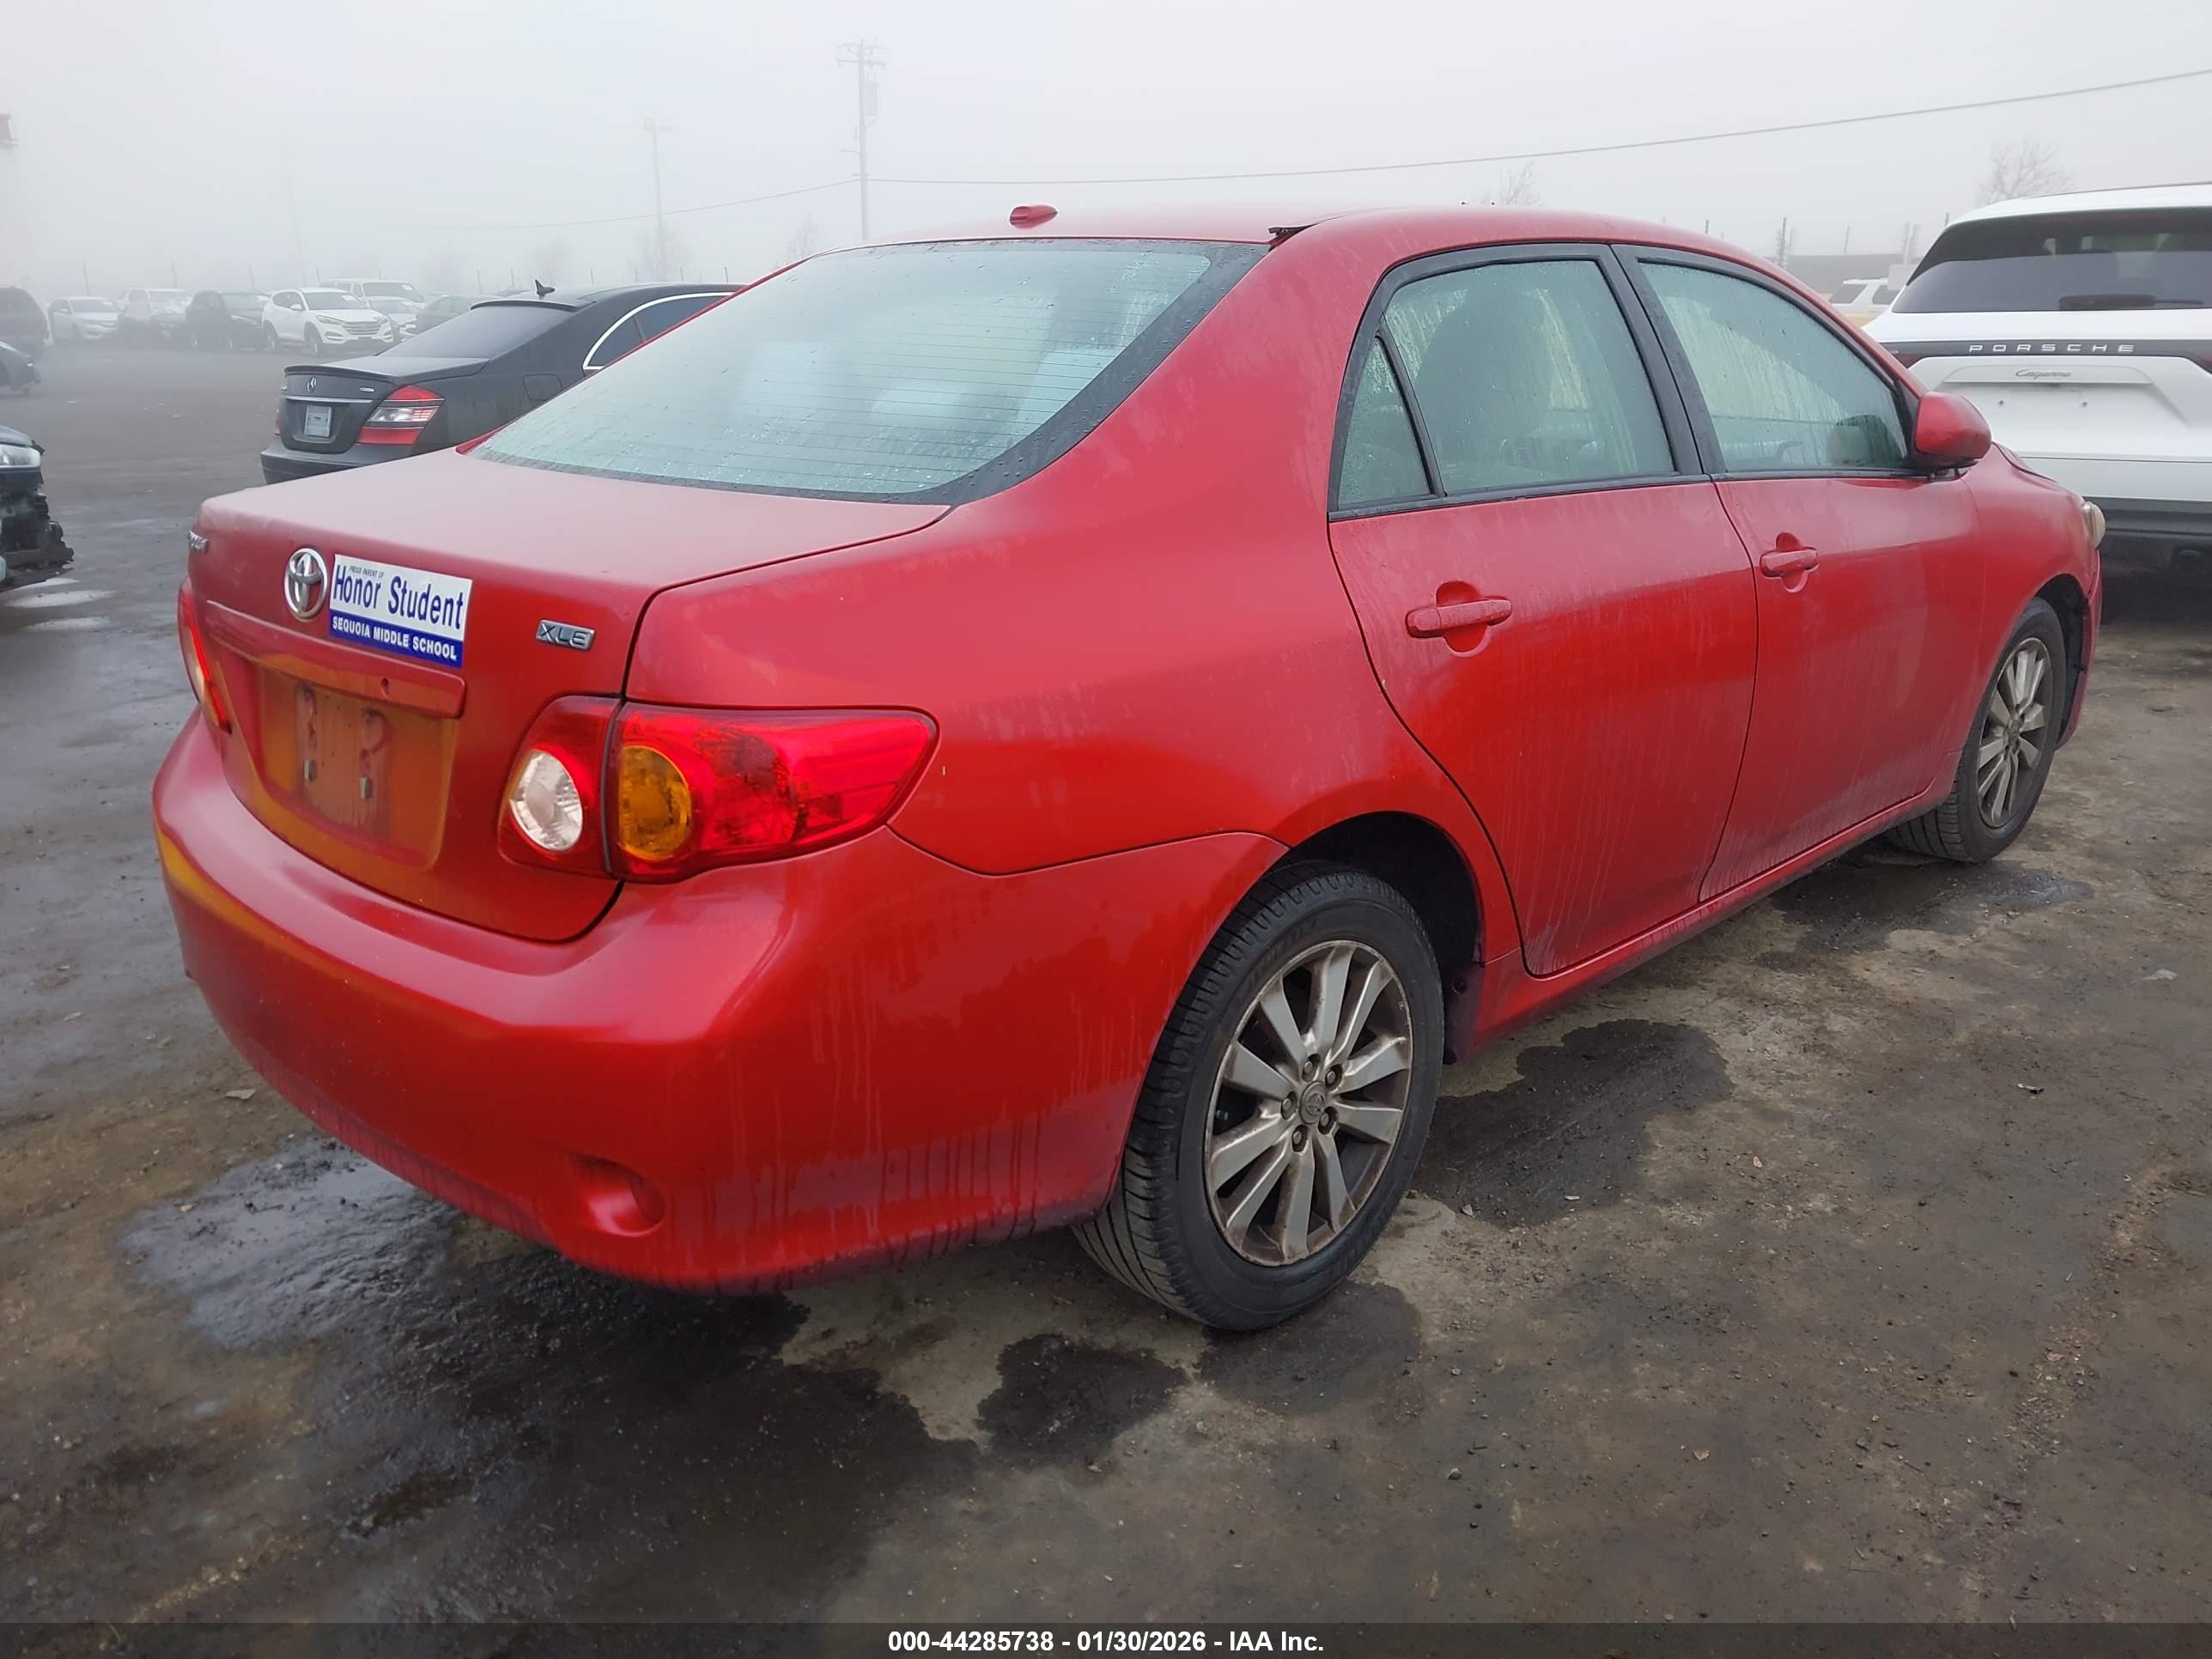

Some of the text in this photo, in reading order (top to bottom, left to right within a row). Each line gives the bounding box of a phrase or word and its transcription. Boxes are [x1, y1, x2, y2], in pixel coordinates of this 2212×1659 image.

[1969, 344, 2135, 353] PORSCHE
[333, 564, 464, 630] Honor Student
[332, 616, 457, 660] SEQUOIA MIDDLE SCHOOL
[539, 623, 588, 647] XLE
